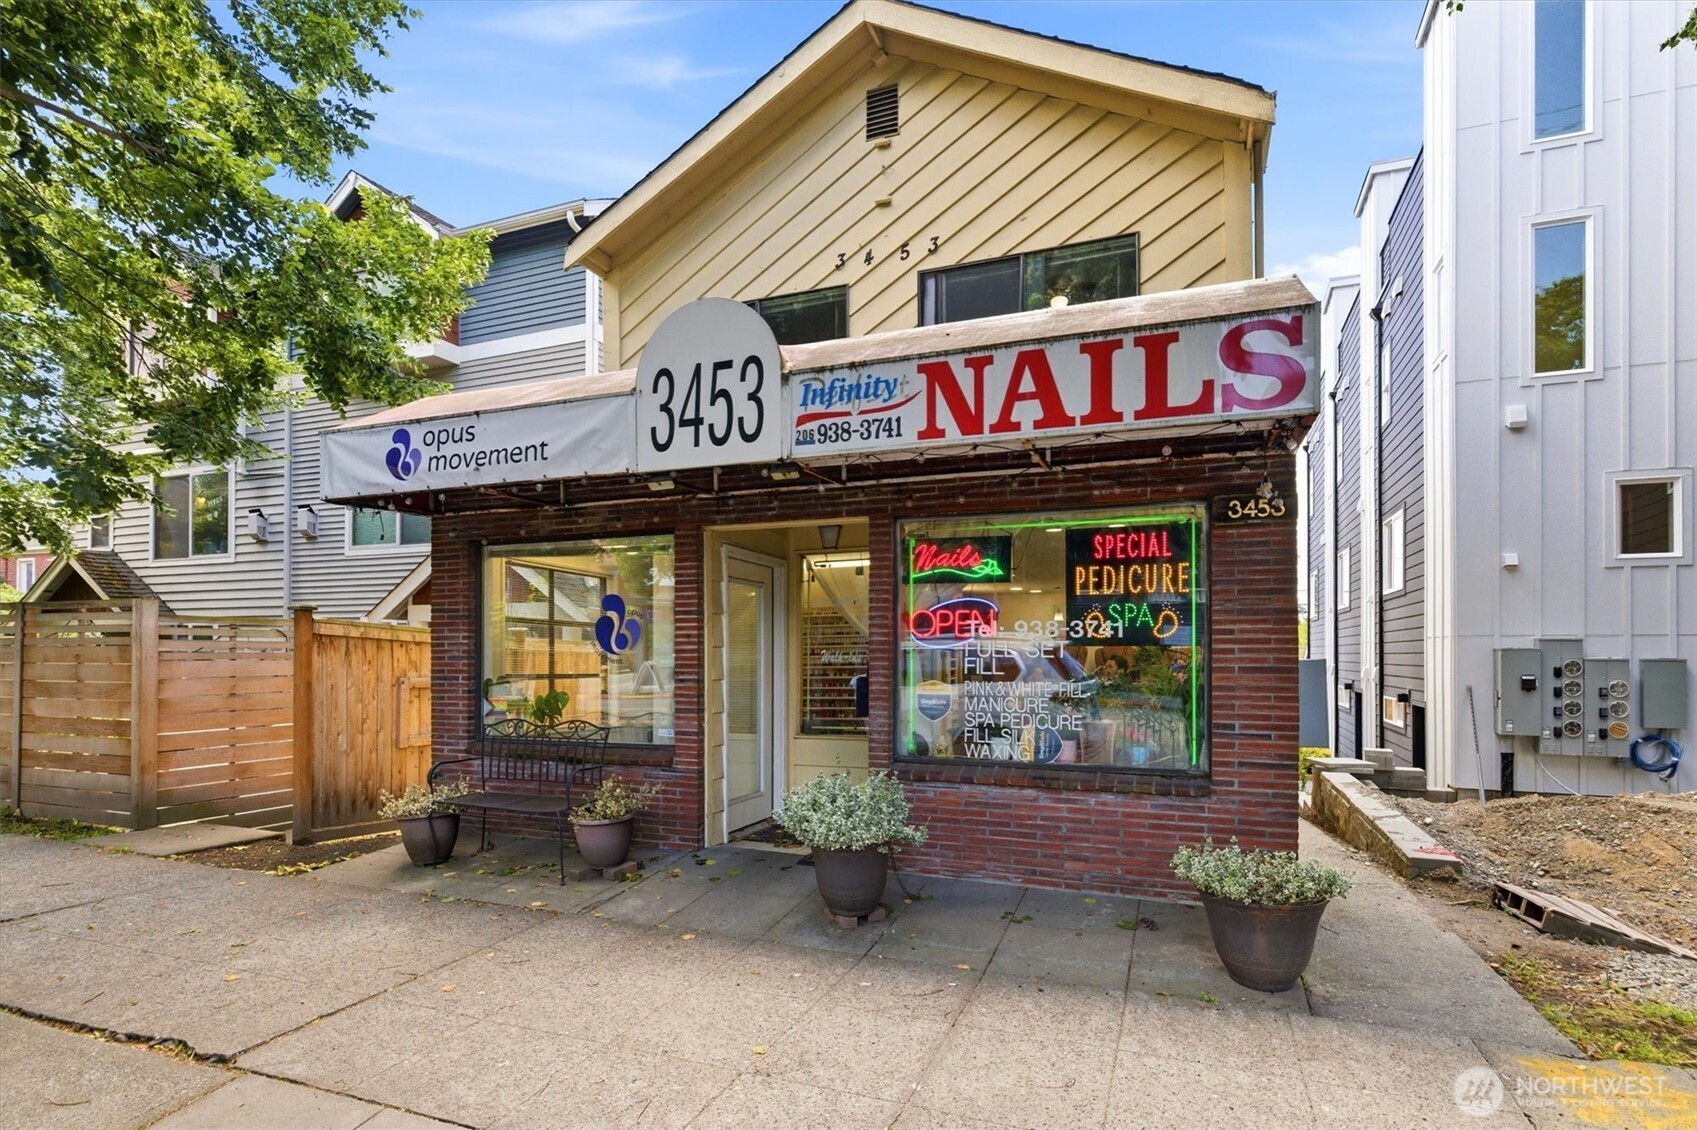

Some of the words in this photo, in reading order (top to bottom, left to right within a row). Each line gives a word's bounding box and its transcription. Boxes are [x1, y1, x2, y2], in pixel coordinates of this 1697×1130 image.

[917, 315, 1307, 441] NAILS
[650, 354, 765, 453] 3453
[800, 374, 899, 410] Infinity
[423, 425, 476, 451] opus
[796, 429, 815, 441] 206
[817, 416, 903, 444] 938-3741
[428, 440, 549, 472] movement
[1228, 498, 1286, 519] 3453
[1094, 531, 1172, 559] SPECIAL
[914, 543, 981, 573] Nails
[1075, 562, 1190, 596] PEDICURE
[911, 608, 994, 637] OPEN
[1108, 602, 1155, 627] SPA
[965, 619, 1005, 638] Tel:
[1014, 620, 1124, 638] 938-3741
[964, 640, 1014, 658] FULL
[1026, 640, 1069, 659] SET
[964, 657, 1005, 675] FILL
[964, 681, 993, 697] PINK
[995, 681, 1006, 697] &
[1008, 681, 1053, 698] WHITE
[1059, 682, 1085, 698] FILL
[964, 697, 1050, 714] MANICURE
[964, 712, 995, 727] SPA
[1000, 713, 1084, 731] PEDICURE
[964, 728, 993, 743] FILL
[1001, 728, 1035, 745] SILK
[964, 743, 1031, 761] WAXING
